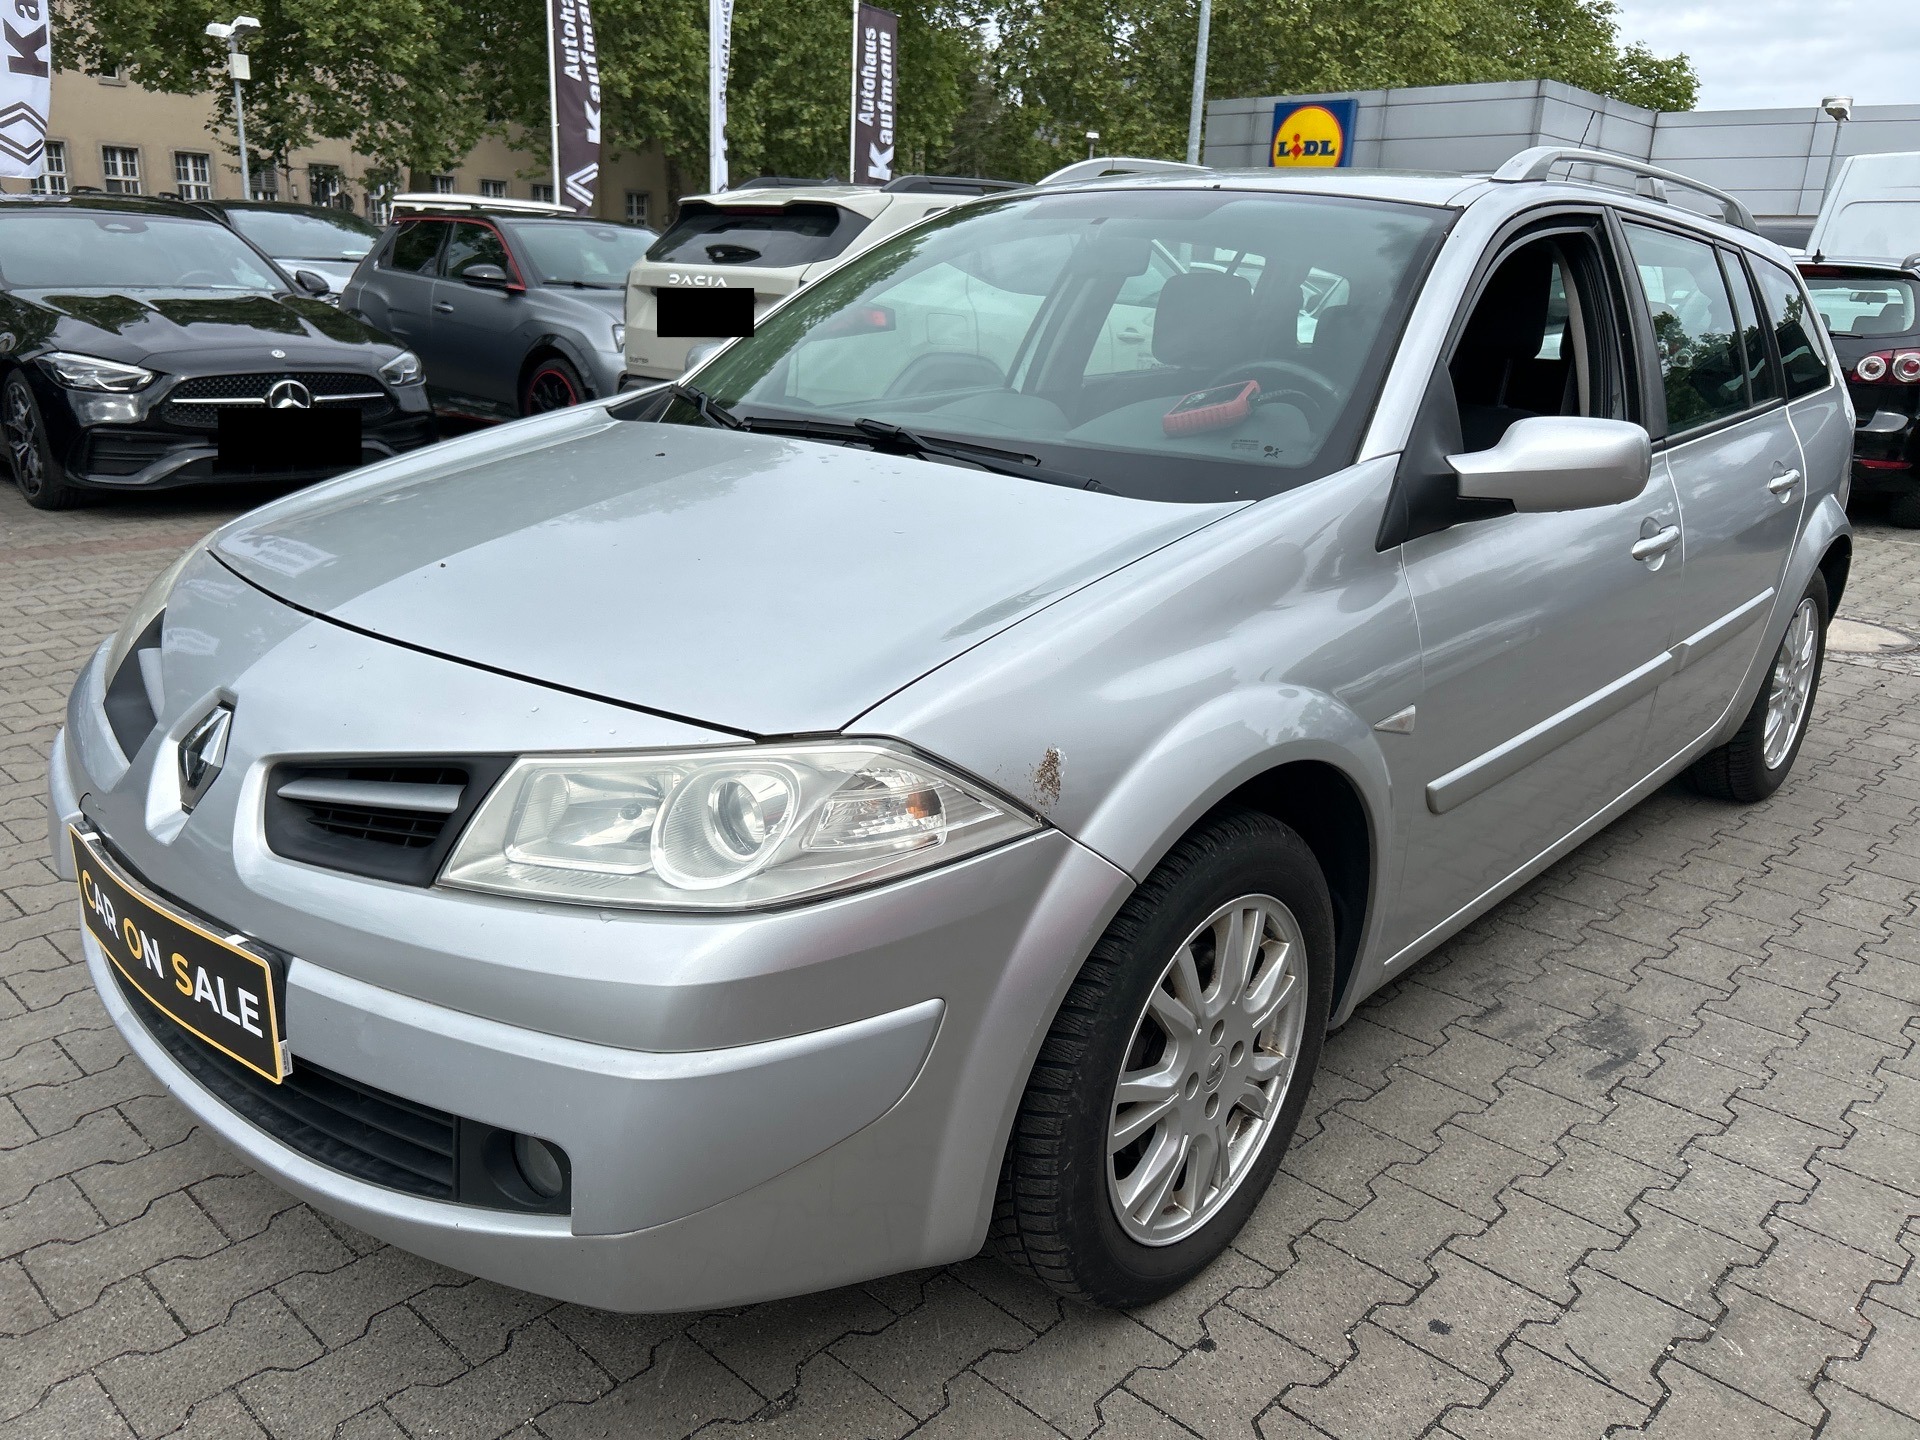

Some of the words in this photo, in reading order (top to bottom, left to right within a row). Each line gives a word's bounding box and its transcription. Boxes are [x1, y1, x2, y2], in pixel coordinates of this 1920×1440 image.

[858, 27, 877, 127] Autohaus
[868, 31, 895, 181] Kaufmann
[669, 273, 727, 287] DACIA
[82, 869, 119, 939] CAR
[123, 918, 163, 979] ON
[172, 953, 263, 1038] SALE
